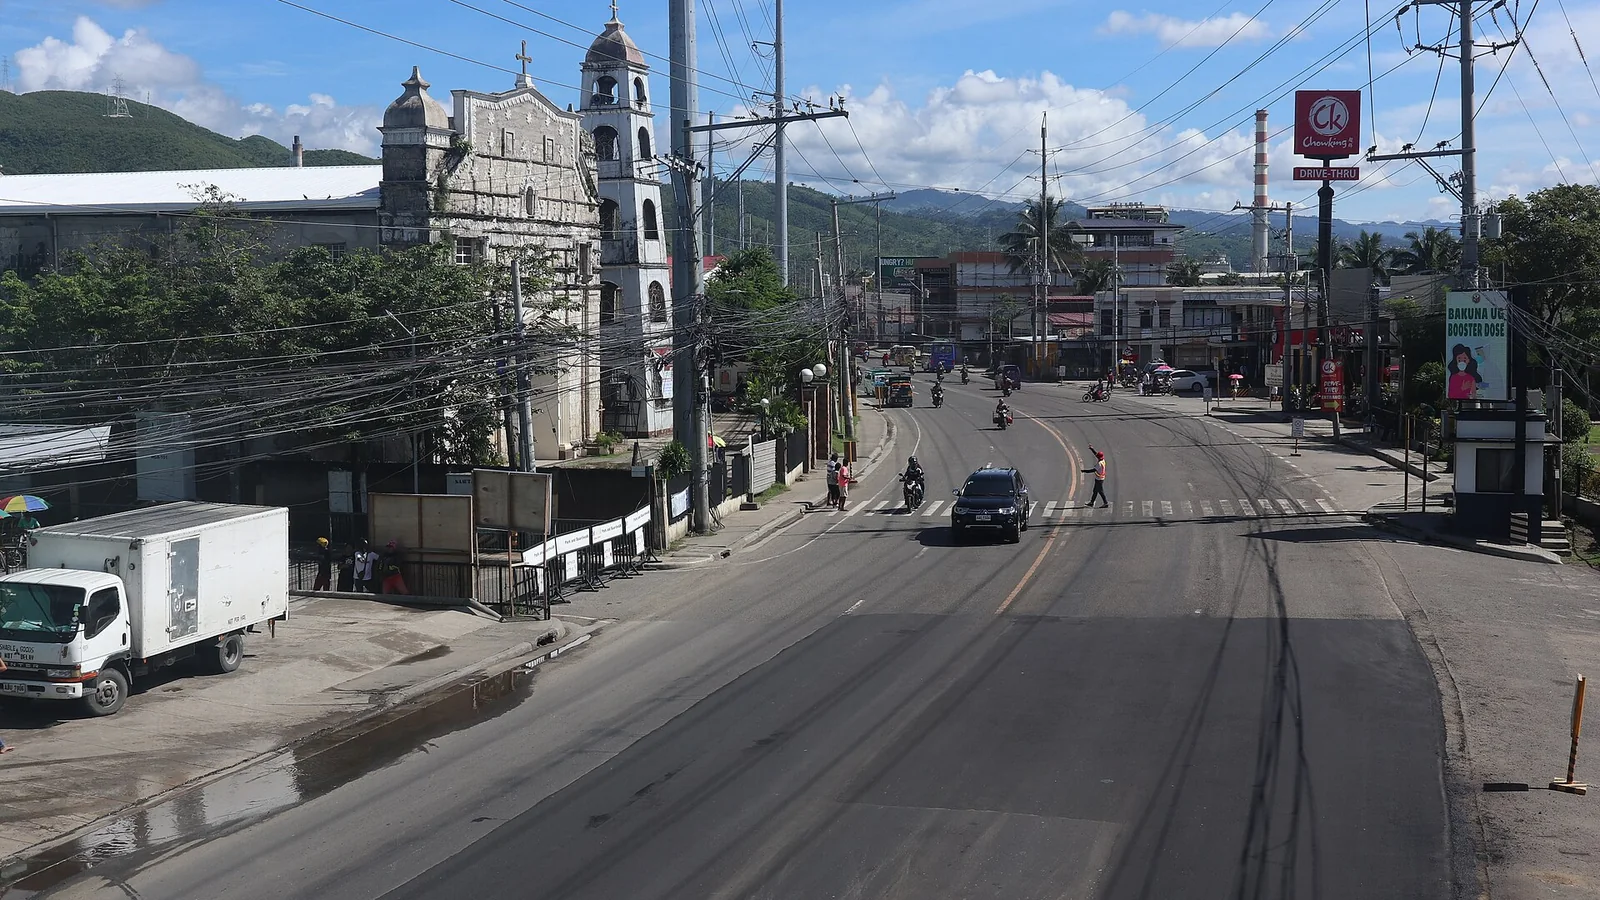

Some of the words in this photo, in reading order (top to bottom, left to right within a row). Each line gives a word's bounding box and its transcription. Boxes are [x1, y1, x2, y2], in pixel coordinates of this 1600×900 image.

[1303, 137, 1347, 148] Chowking
[1300, 169, 1356, 178] DRIVE-THRU
[1448, 308, 1488, 319] BAKUNA
[1490, 308, 1505, 320] UG
[1448, 323, 1483, 336] BOOSTER
[1484, 323, 1504, 336] DOSE
